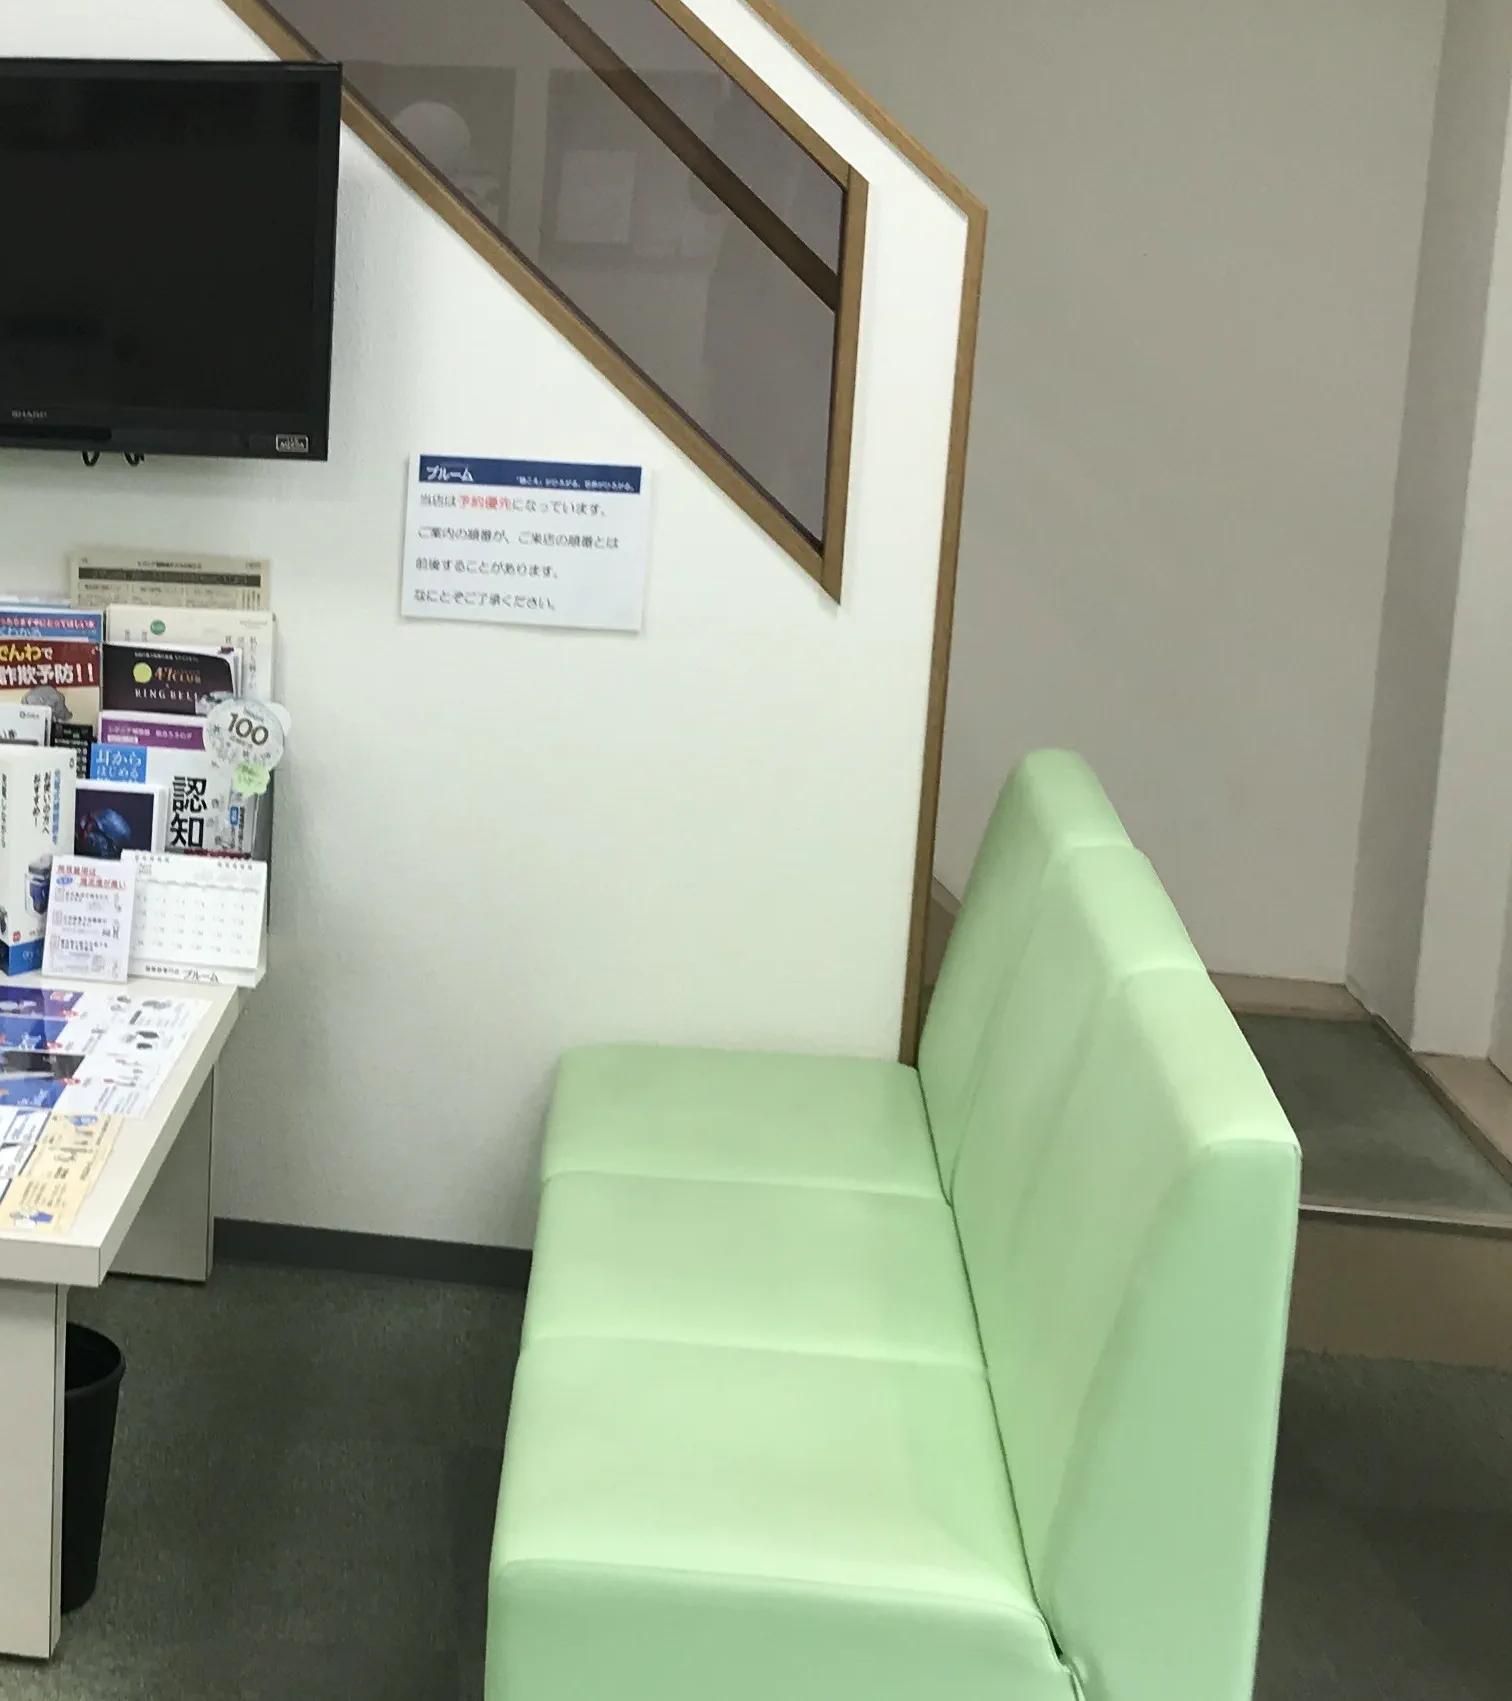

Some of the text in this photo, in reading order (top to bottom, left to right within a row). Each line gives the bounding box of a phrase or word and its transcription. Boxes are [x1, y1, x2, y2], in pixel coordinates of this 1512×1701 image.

[426, 465, 474, 483] ブルーム
[419, 493, 608, 517] 当店は予約優先になっています。
[415, 555, 559, 579] 前後することがあります。
[413, 587, 557, 611] なにとぞご了承ください。
[134, 688, 167, 700] RING
[228, 712, 269, 746] 100
[183, 967, 220, 985] ブルーム
